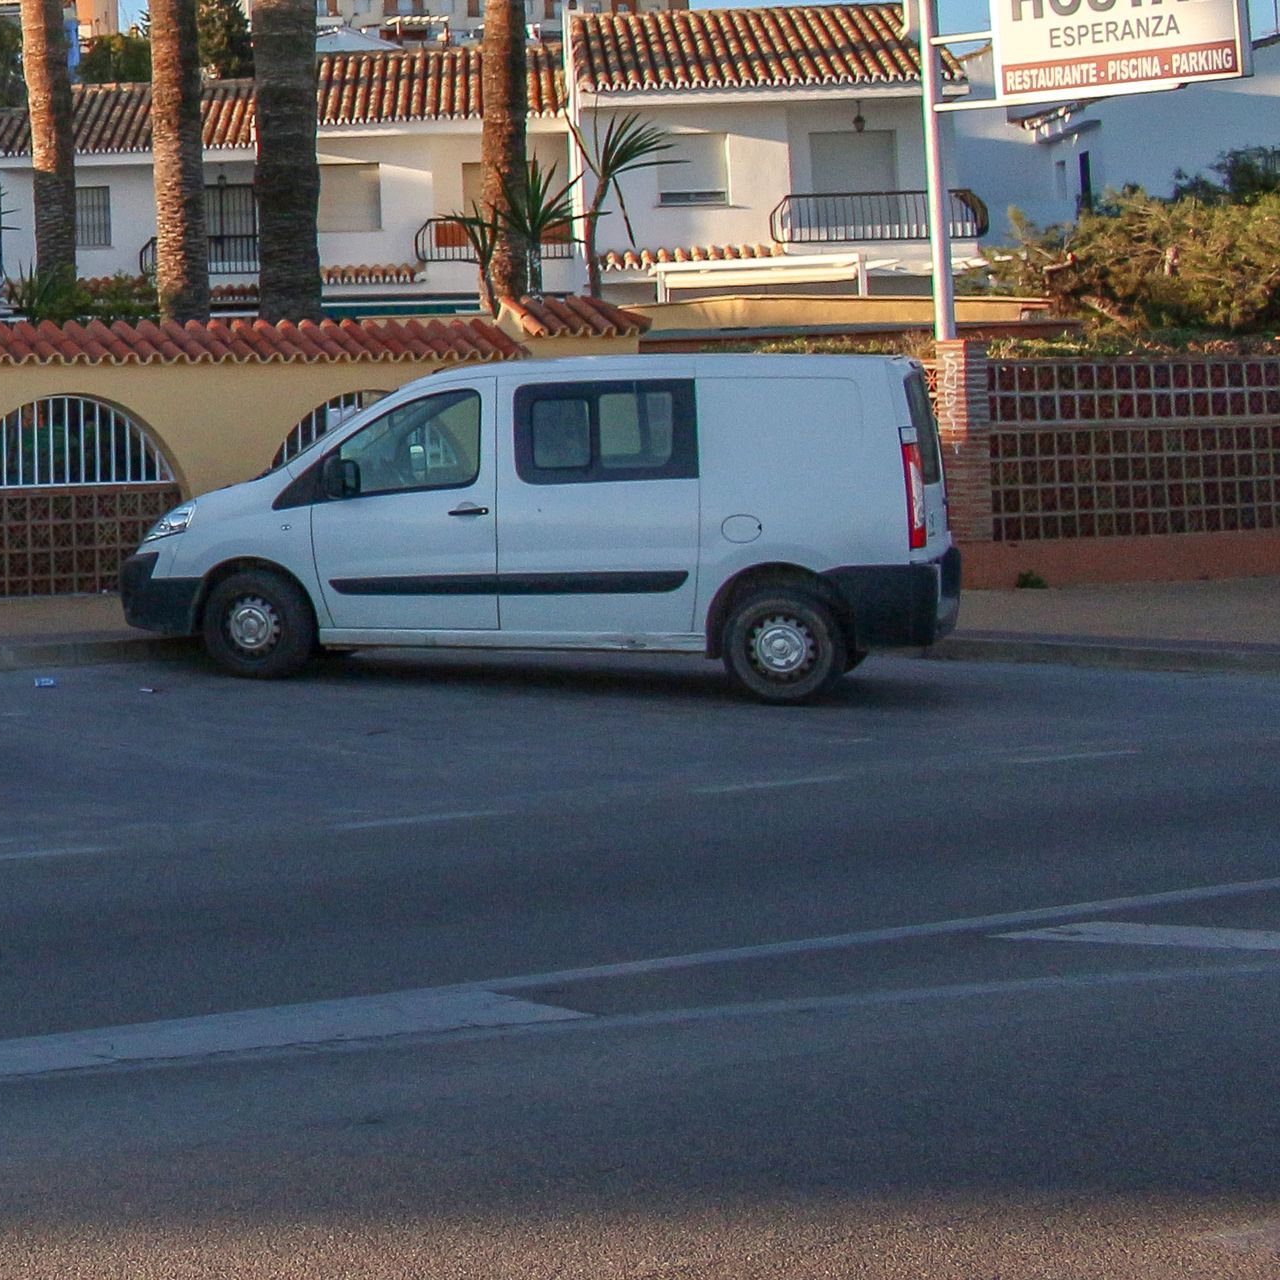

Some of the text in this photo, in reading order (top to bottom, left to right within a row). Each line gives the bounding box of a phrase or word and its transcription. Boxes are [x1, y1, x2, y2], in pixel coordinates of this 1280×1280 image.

[1049, 13, 1181, 49] ESPERANZA
[1005, 46, 1234, 93] RESTAURANTE PISCINA PARKING
